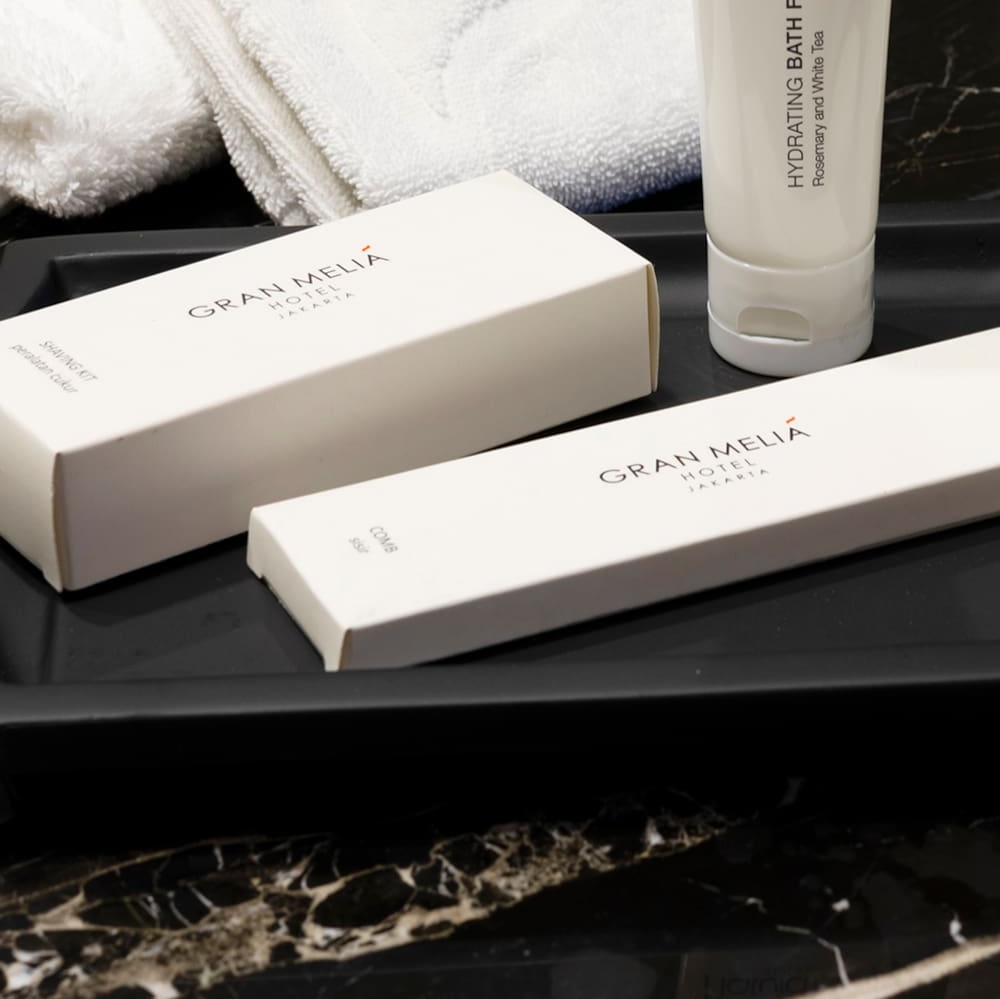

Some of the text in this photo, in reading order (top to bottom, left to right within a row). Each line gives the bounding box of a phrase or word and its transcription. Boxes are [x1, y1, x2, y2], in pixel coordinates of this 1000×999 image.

[786, 17, 803, 69] BATH
[811, 30, 827, 187] Rosemary and White Tea
[787, 77, 804, 188] HYDRATING
[188, 245, 389, 318] GRAN MELIÁ
[268, 284, 342, 310] HOTEL
[278, 292, 355, 320] JAKARTA
[39, 340, 98, 382] SHAVING KIT
[599, 416, 811, 484] GRAN MELIÁ
[681, 458, 756, 482] HOTEL
[688, 468, 770, 493] JAKARTA
